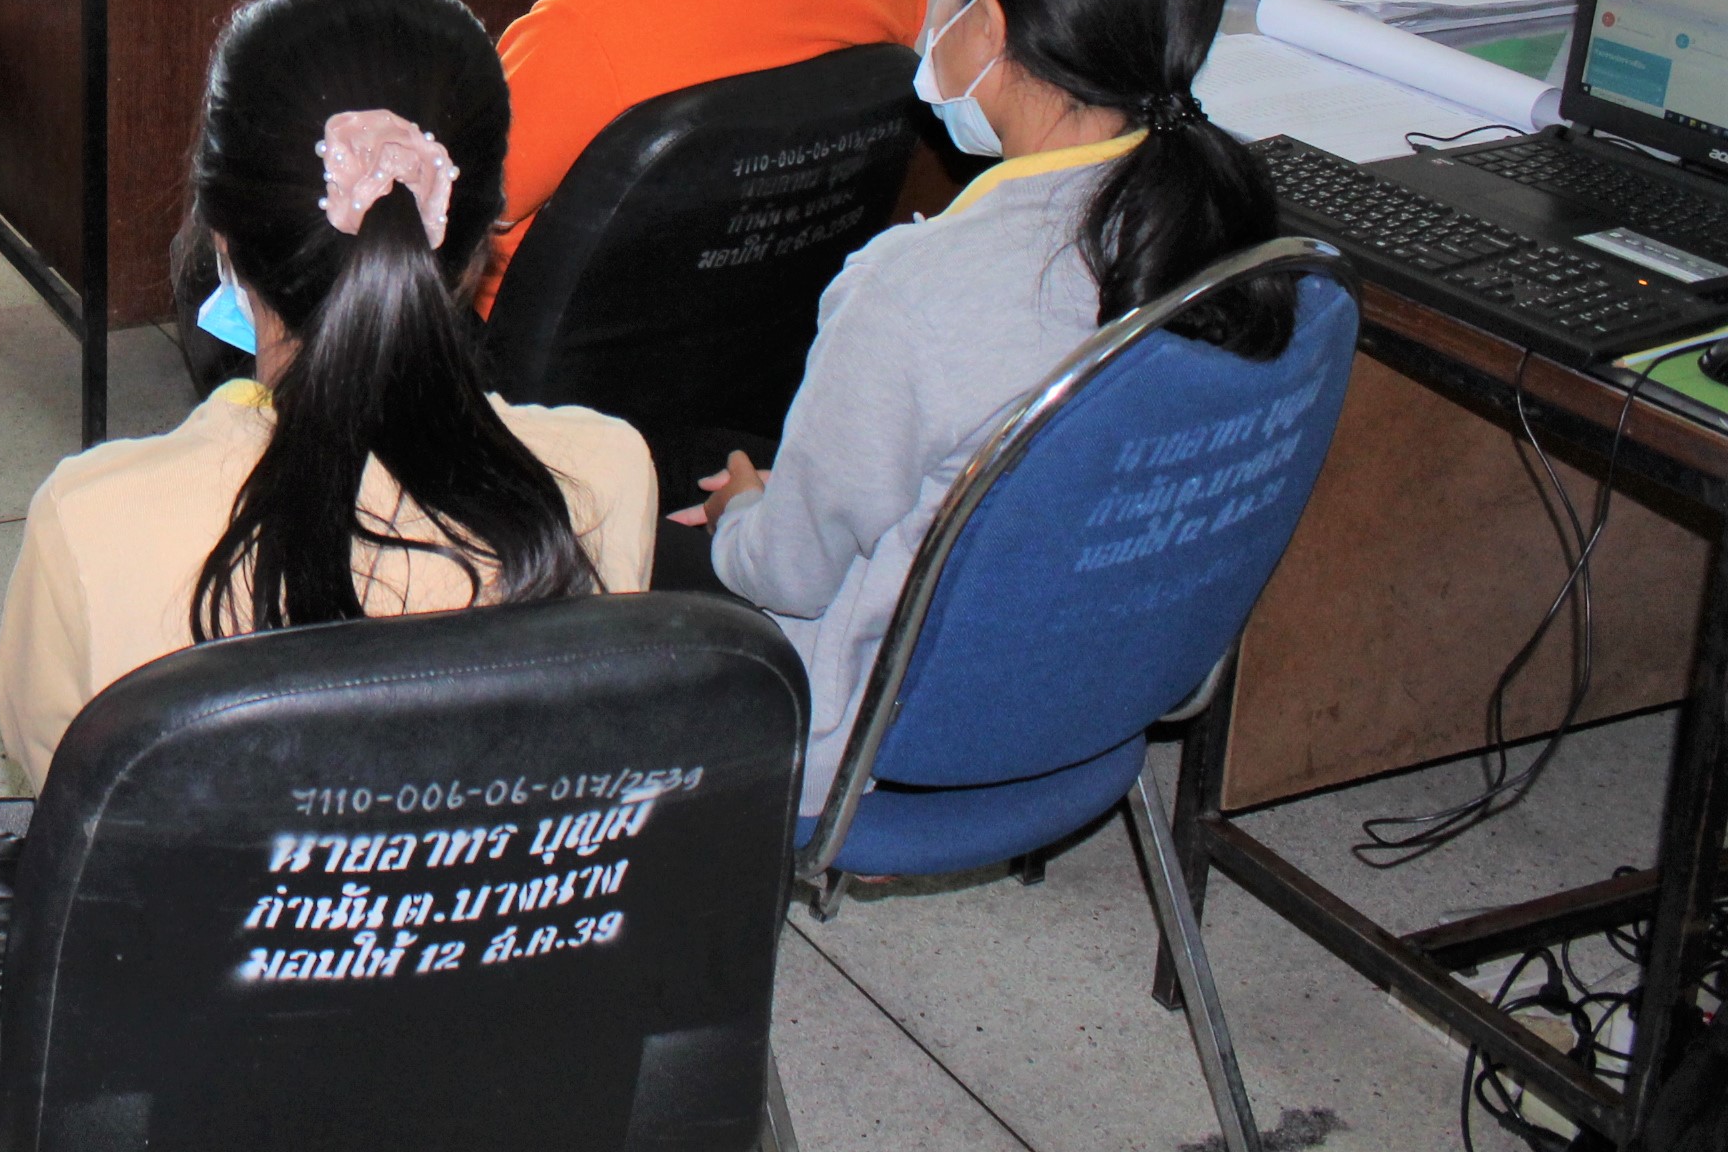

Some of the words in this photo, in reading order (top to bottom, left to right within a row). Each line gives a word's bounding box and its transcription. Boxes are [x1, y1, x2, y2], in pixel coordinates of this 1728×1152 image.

[292, 766, 704, 816] 7110-006-06-017/2539
[269, 822, 519, 873] นายอาทร
[234, 923, 419, 982] มอบให้
[414, 939, 467, 974] 12
